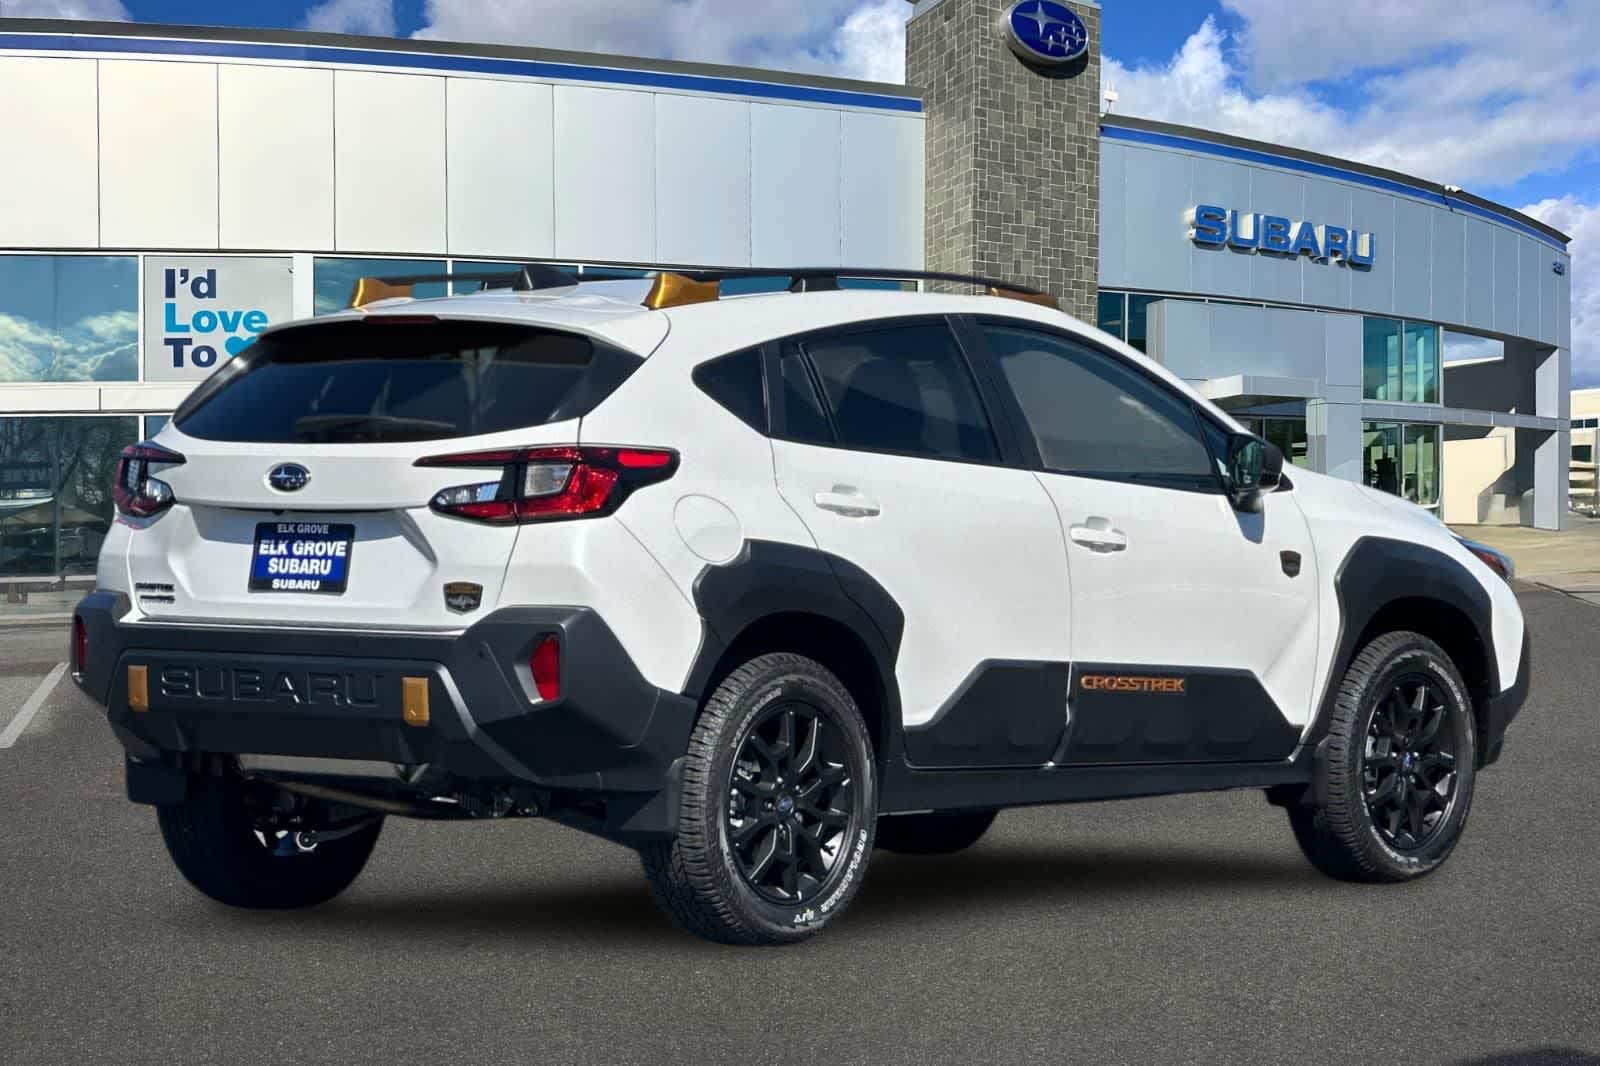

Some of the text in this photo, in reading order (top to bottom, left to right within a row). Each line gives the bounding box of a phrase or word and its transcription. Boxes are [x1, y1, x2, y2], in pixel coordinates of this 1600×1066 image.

[1188, 204, 1376, 268] SUBARU
[165, 303, 268, 333] Love
[164, 338, 217, 368] To
[277, 523, 329, 534] ELK GROVE
[259, 540, 347, 557] ELK GROVE
[268, 557, 332, 575] SUBARU
[272, 579, 320, 590] SUBARU
[160, 664, 384, 707] SUBARU
[1081, 675, 1185, 692] CROSSTREK
